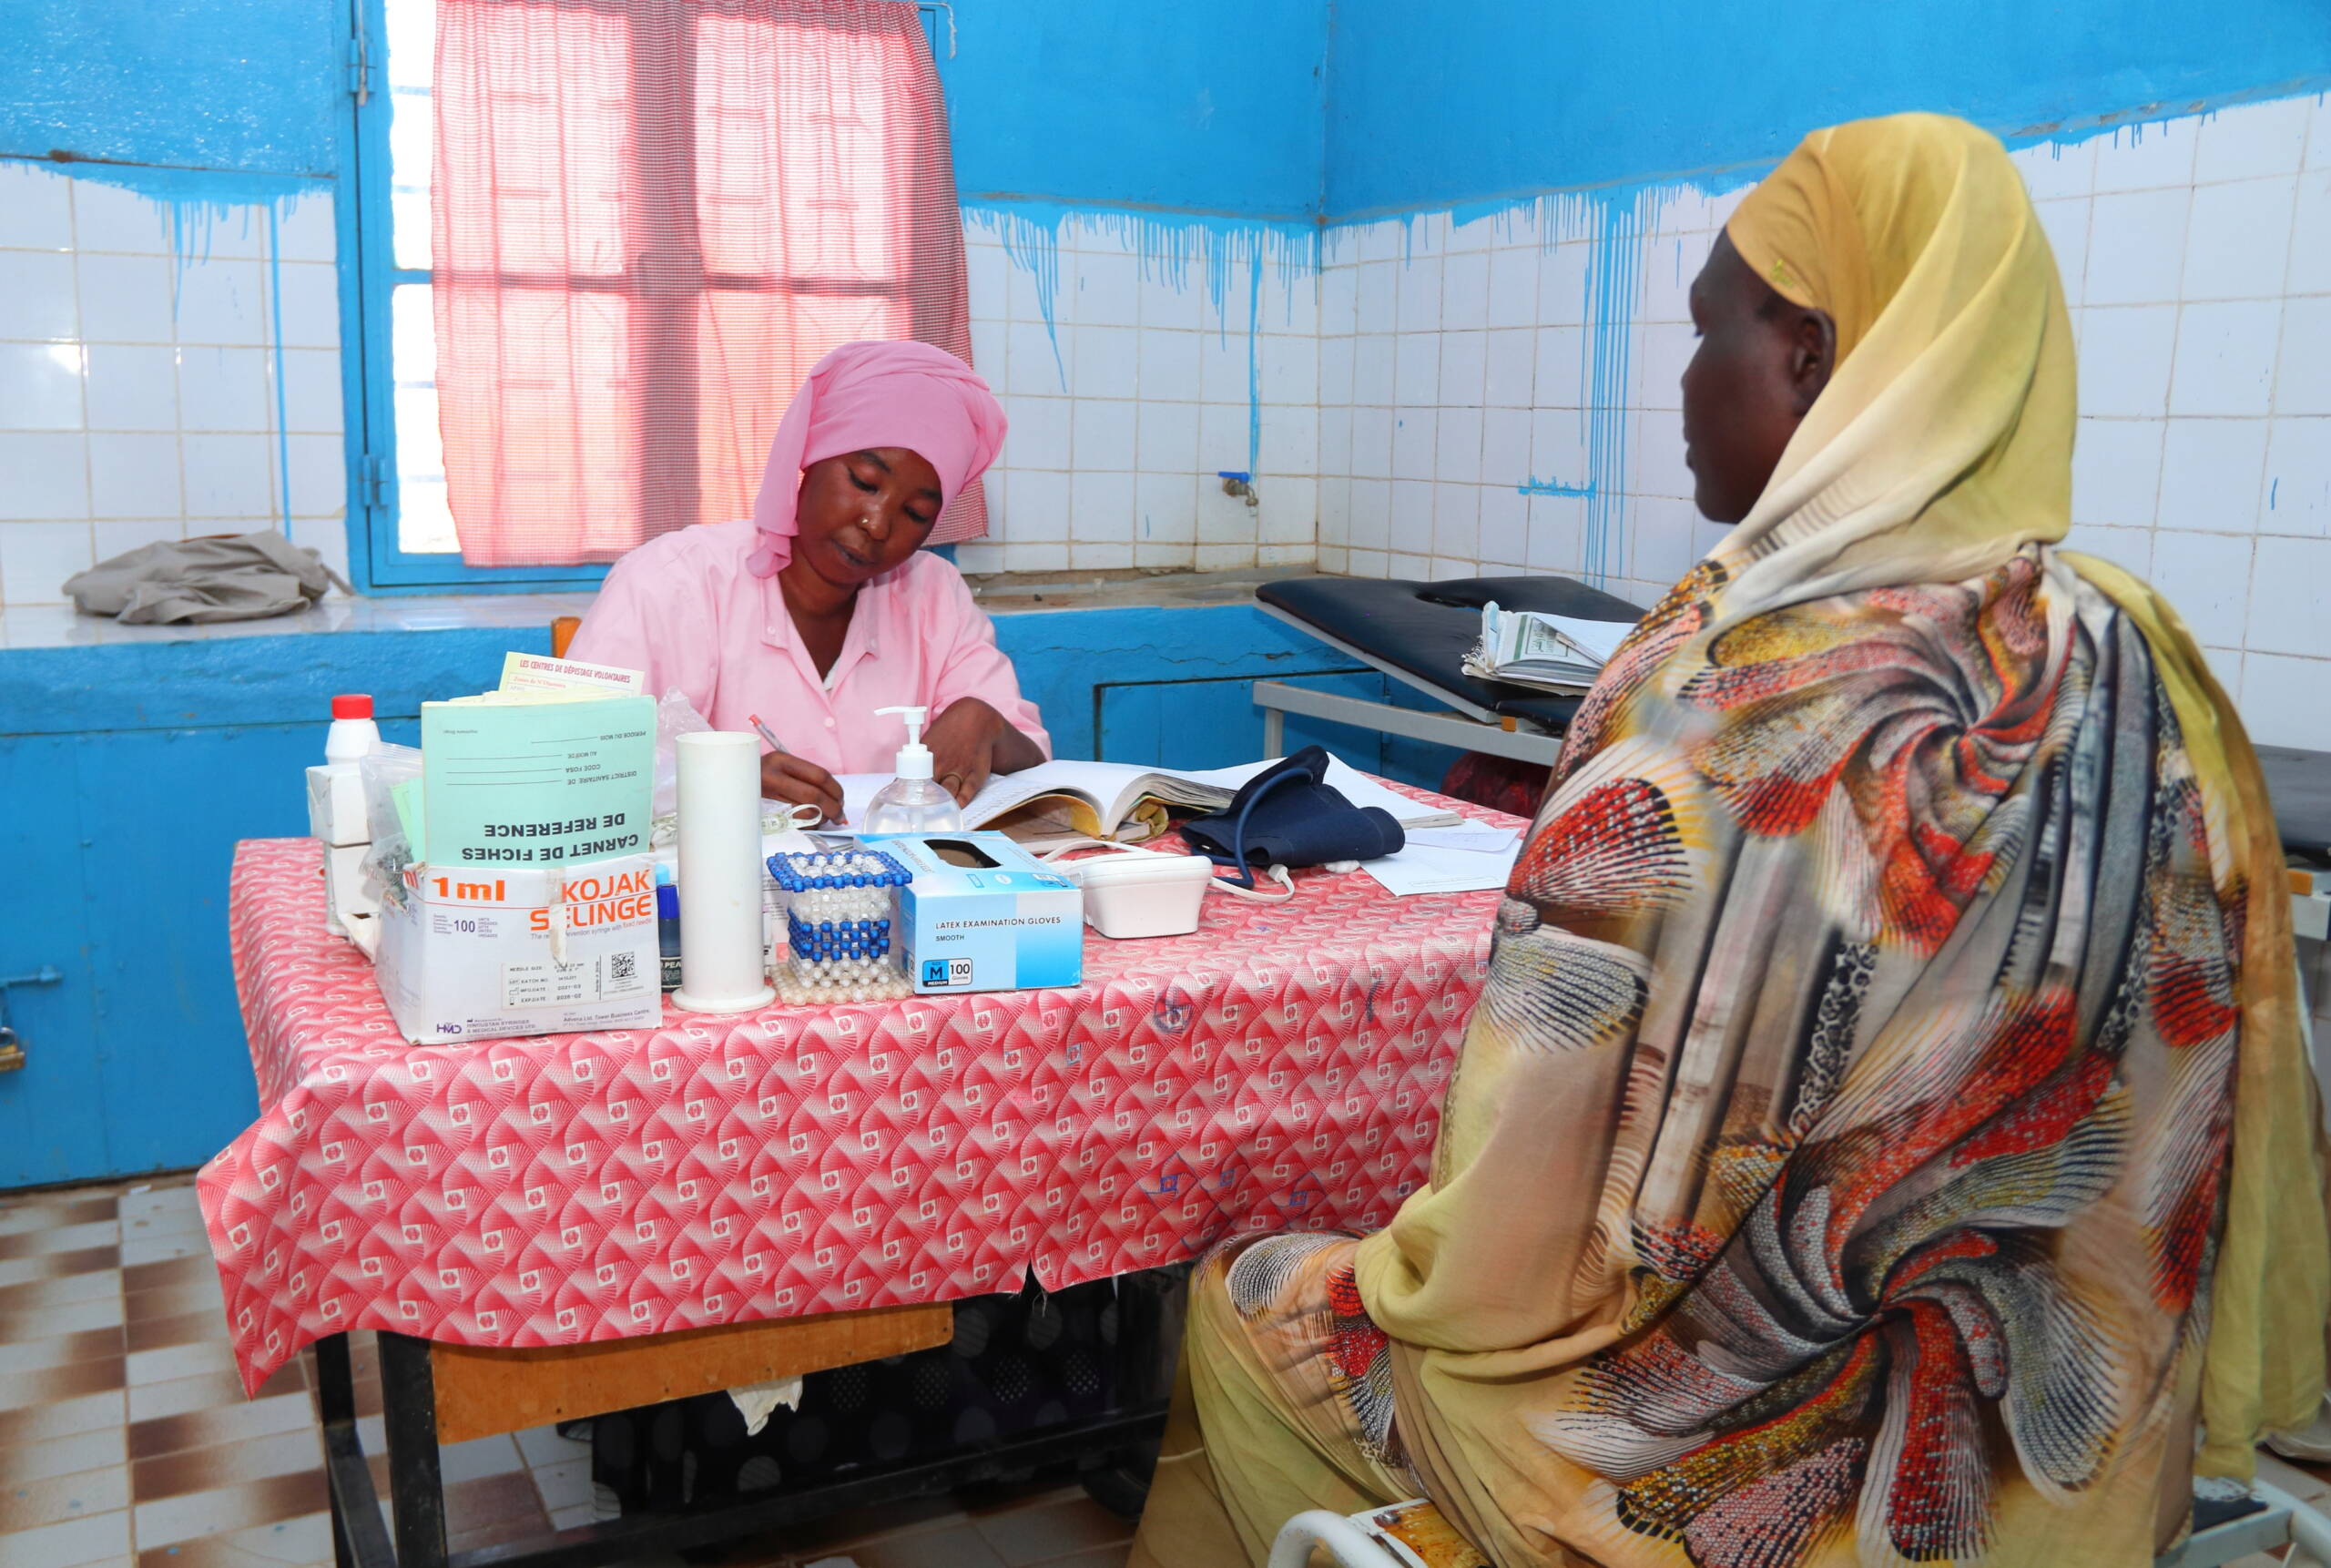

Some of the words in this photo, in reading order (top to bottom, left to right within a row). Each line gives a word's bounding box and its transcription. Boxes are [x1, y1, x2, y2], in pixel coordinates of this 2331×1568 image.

[520, 659, 529, 667] LES
[531, 661, 555, 671] CENTRES
[564, 665, 593, 677] DÉPISTAGE
[594, 670, 631, 683] VOLONTAIRES
[624, 730, 646, 738] PERIODE
[579, 774, 610, 784] SANITAIRE
[611, 770, 637, 780] DISTRICT
[603, 812, 626, 828] DE
[484, 817, 597, 837] REFERENCE
[569, 834, 639, 858] CARNET
[462, 848, 533, 860] FICHES
[540, 846, 564, 860] DE
[561, 869, 650, 903] KOJAK
[530, 894, 651, 931] SLINGE
[454, 920, 475, 932] 100
[935, 921, 961, 929] LATEX
[963, 918, 1025, 928] EXAMINATION
[1028, 916, 1061, 924] GLOVES
[930, 966, 942, 979] M
[950, 963, 970, 974] 100
[437, 1023, 463, 1034] HMD
